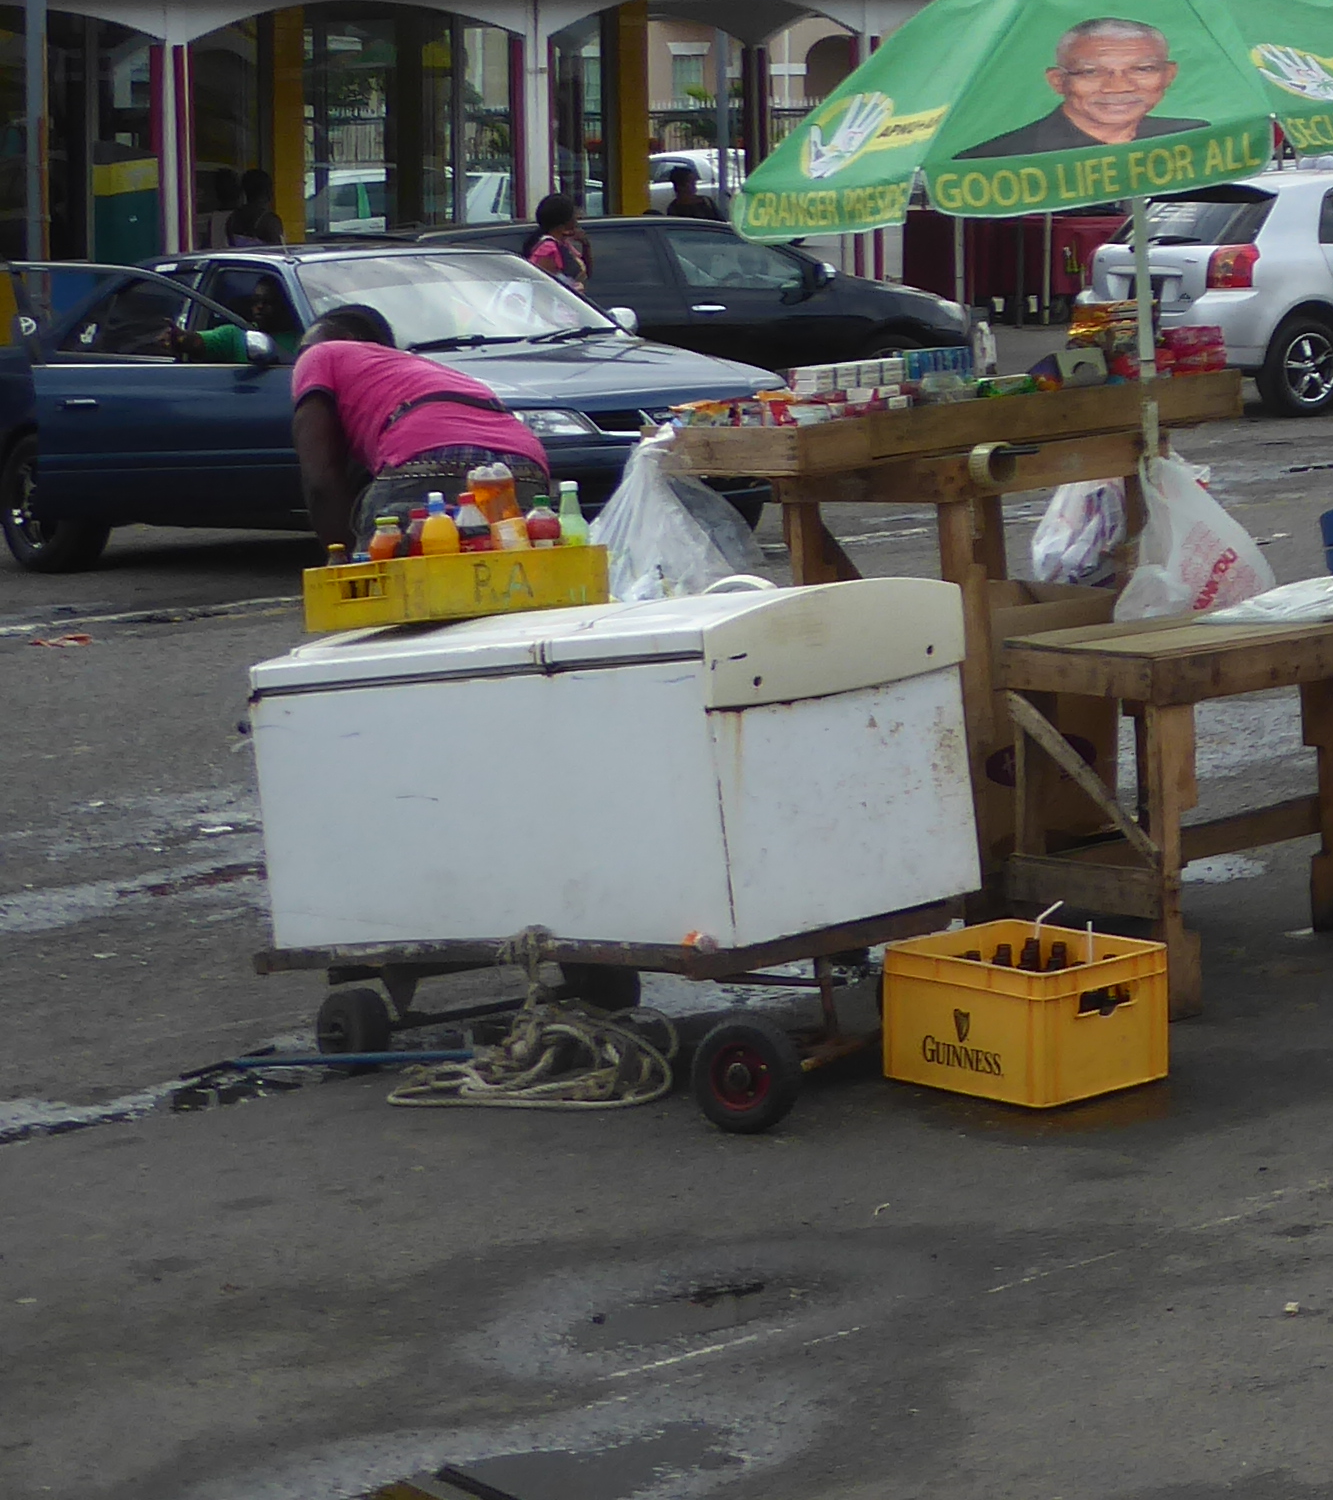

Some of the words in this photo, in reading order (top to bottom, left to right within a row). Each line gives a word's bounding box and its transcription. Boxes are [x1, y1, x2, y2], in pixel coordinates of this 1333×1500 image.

[935, 166, 1047, 209] GOOD
[1056, 155, 1120, 199] LIFE
[1127, 145, 1195, 190] FOR
[1205, 132, 1261, 175] ALL
[750, 190, 839, 227] GRANGER
[922, 1034, 1003, 1077] GUINNESS
